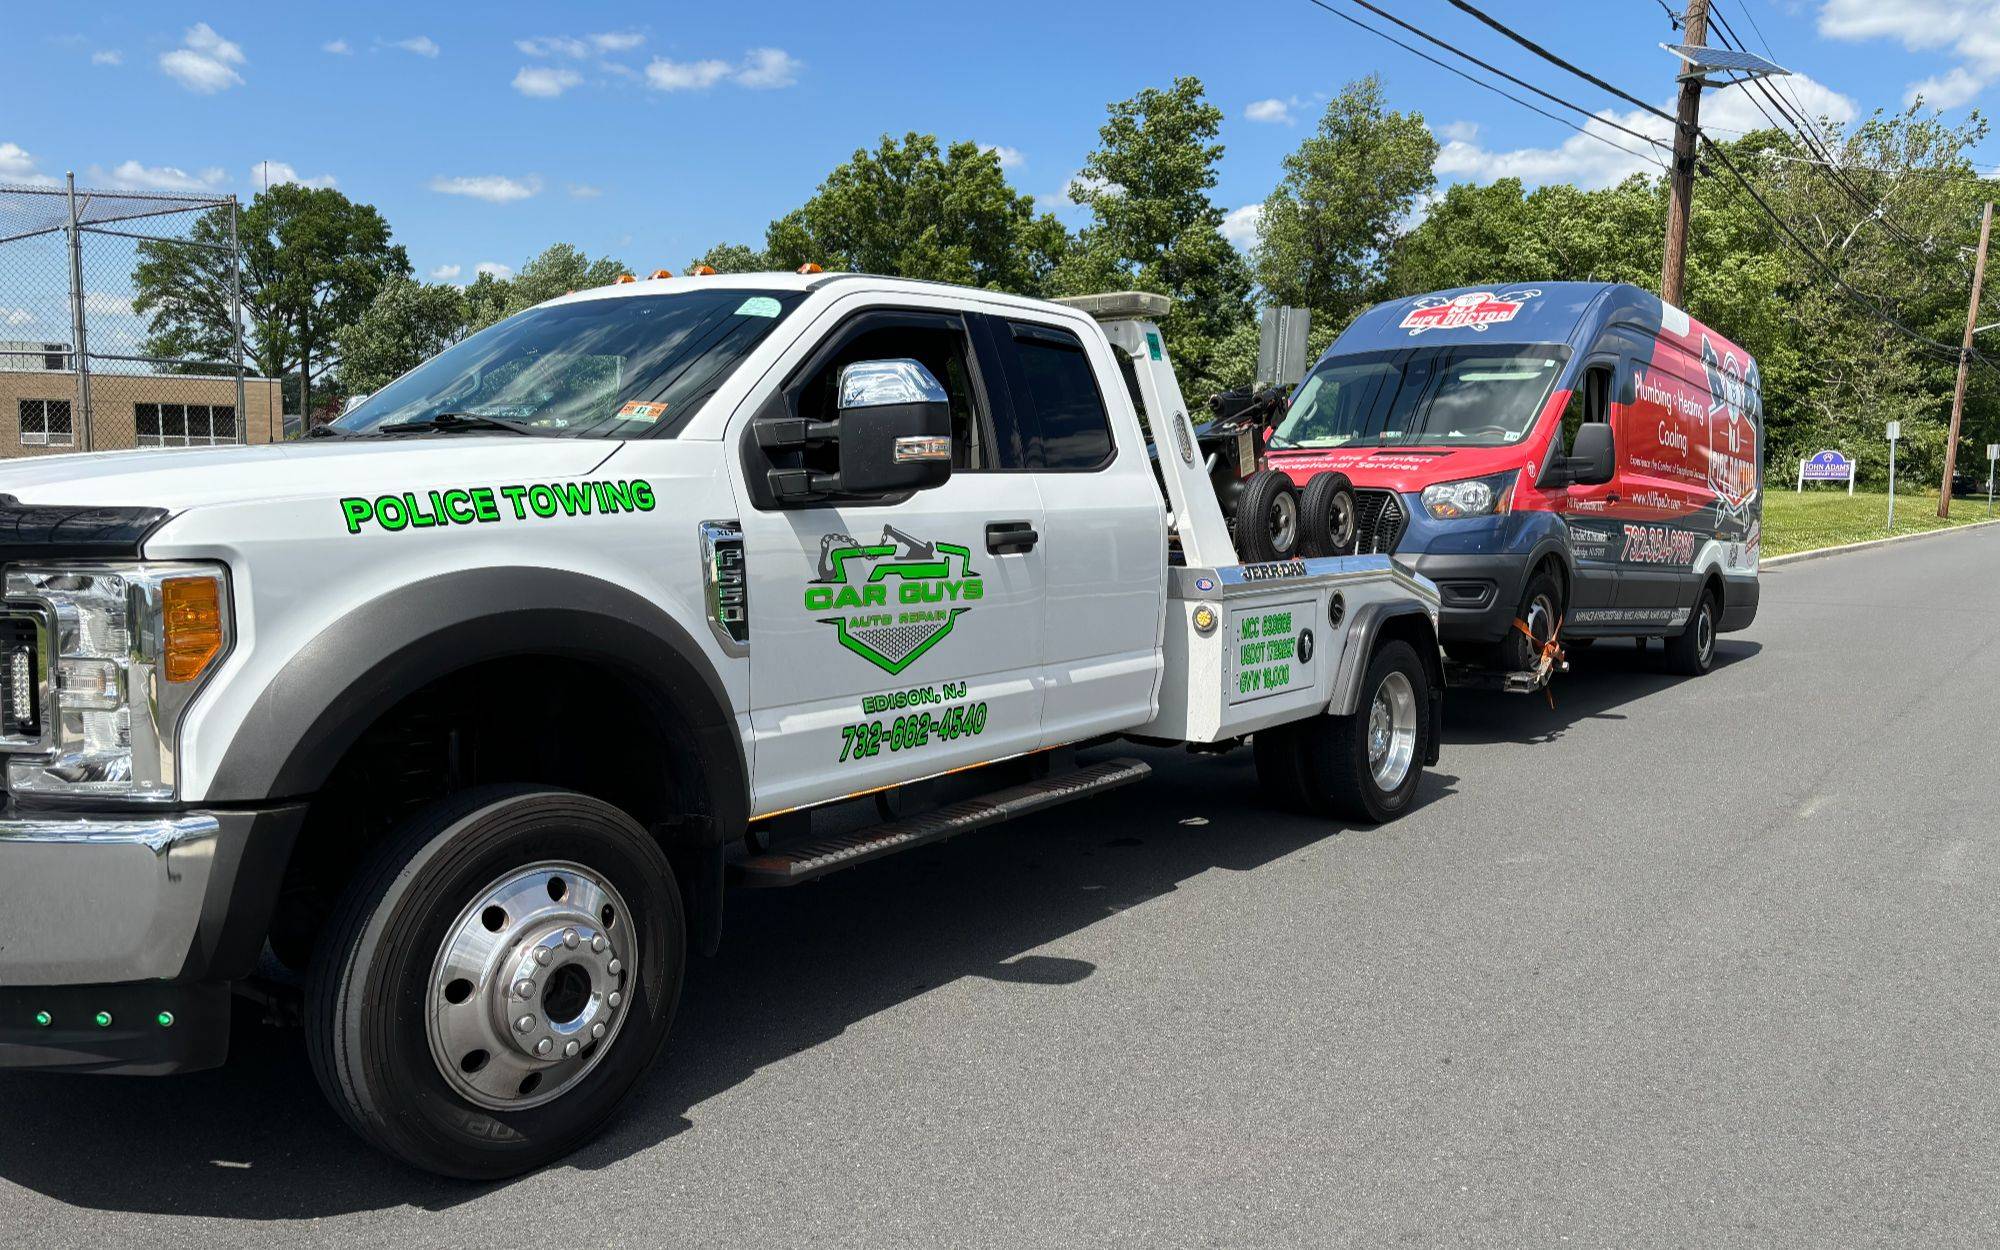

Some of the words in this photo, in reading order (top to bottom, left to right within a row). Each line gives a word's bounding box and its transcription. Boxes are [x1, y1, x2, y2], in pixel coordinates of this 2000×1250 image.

[1407, 314, 1441, 327] PIPE
[1444, 311, 1510, 325] DOCTOR
[1634, 370, 1672, 415] Plumbing
[1677, 388, 1704, 426] Heating
[1658, 418, 1688, 458] Cooling
[1728, 424, 1741, 453] NJ
[1356, 462, 1419, 471] Services
[1711, 450, 1728, 482] PIPE
[1805, 463, 1824, 472] JOHN
[1825, 463, 1850, 472] ADAMS
[340, 486, 500, 533] POLICE
[500, 479, 656, 519] TOWING
[717, 529, 735, 537] XLT
[804, 583, 887, 611] CAR
[898, 579, 984, 604] GUYS
[850, 614, 893, 628] AUTO
[898, 609, 947, 624] REPAIR
[1240, 642, 1266, 666] USDOT
[862, 688, 942, 715] EDISON,
[943, 682, 967, 699] NJ
[839, 702, 987, 763] 732-662-4540
